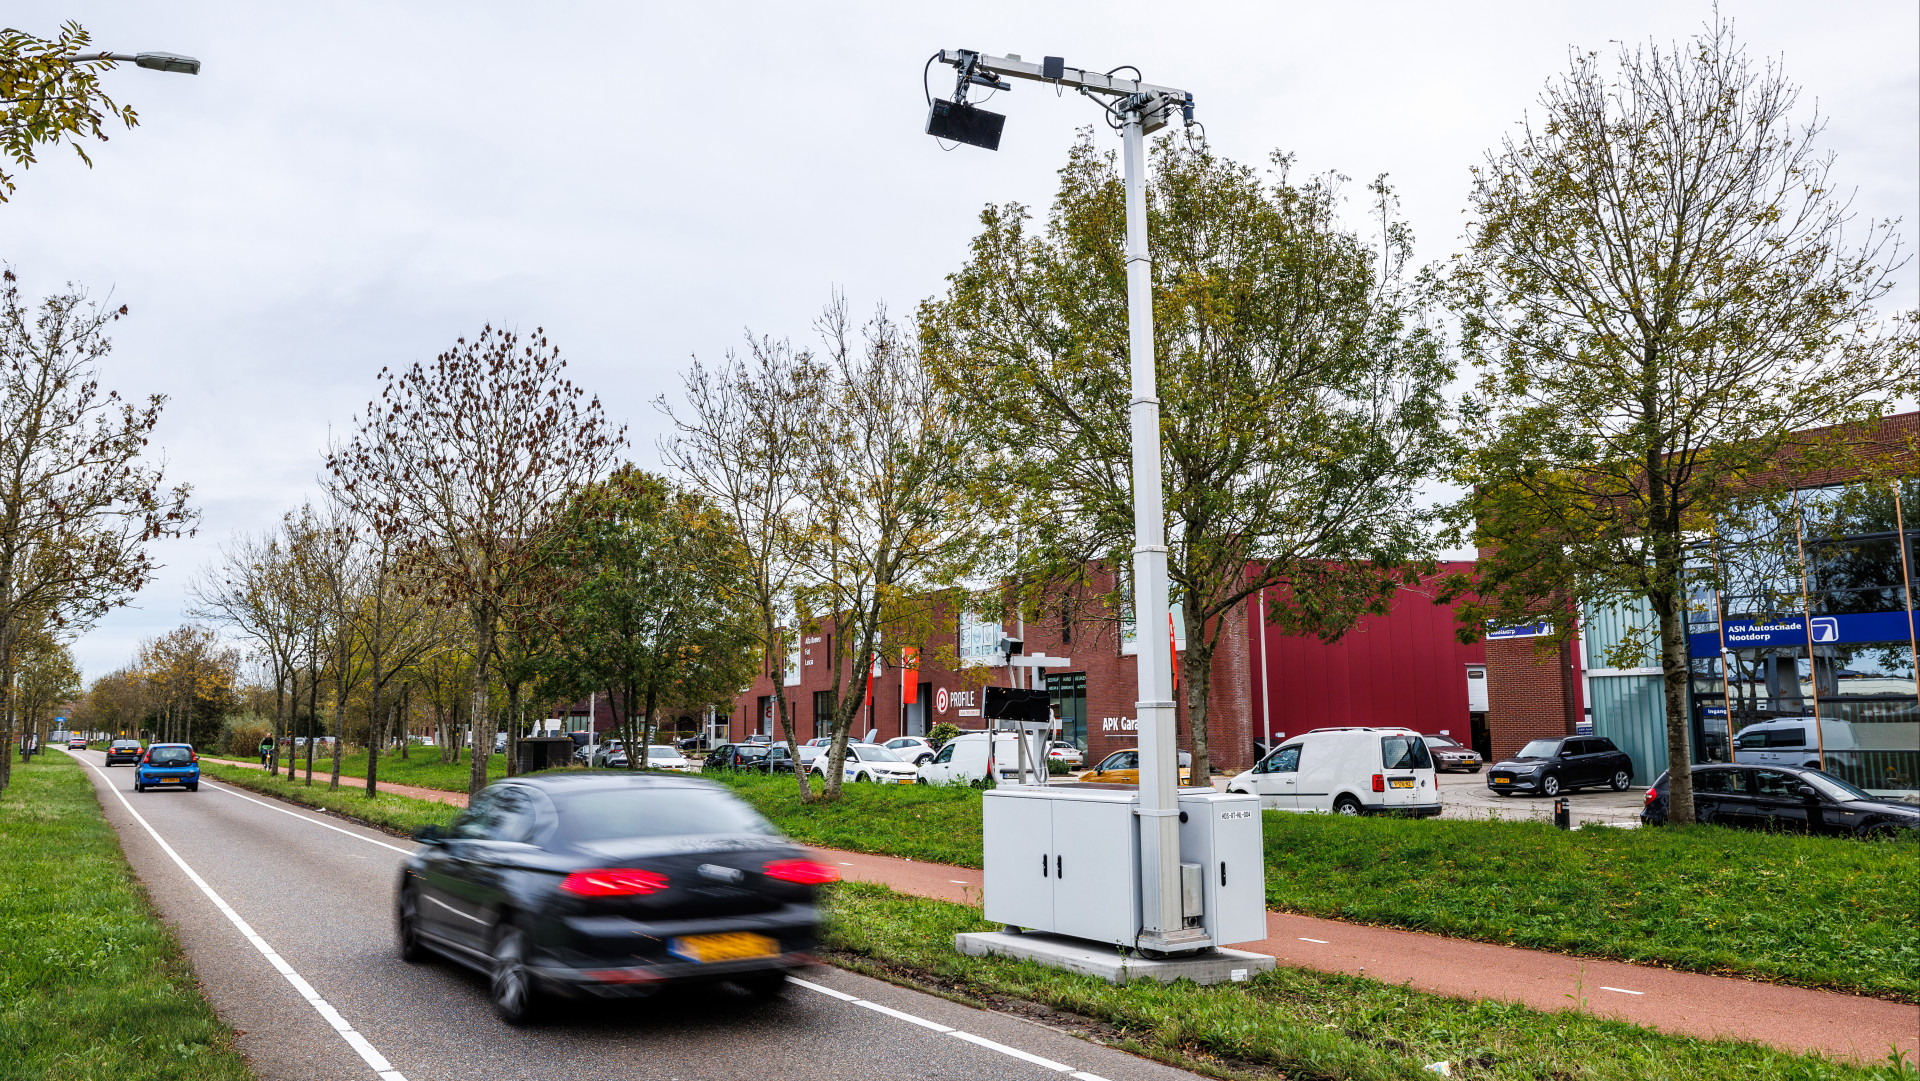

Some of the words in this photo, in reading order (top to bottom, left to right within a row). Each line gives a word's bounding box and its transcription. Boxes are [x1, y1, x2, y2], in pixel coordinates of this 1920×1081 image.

[1728, 625, 1746, 633] ASN
[1748, 622, 1802, 632] Autoschade
[1728, 633, 1771, 641] Nootdorp
[950, 690, 975, 708] PROFILE
[1102, 717, 1119, 731] APK
